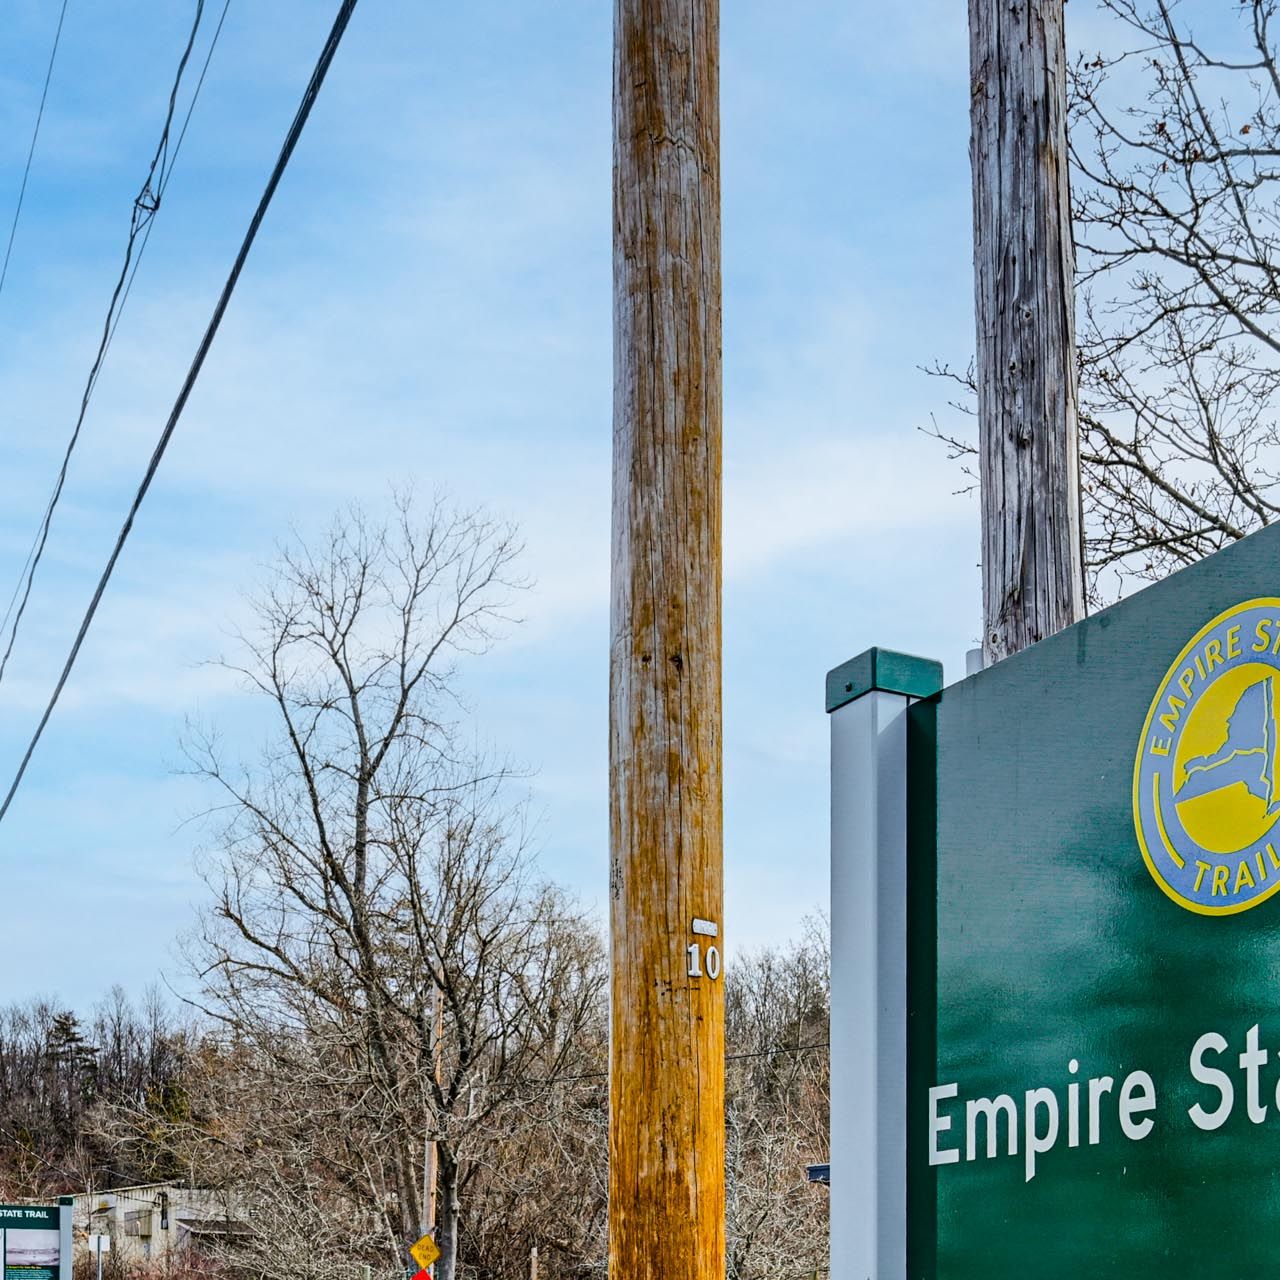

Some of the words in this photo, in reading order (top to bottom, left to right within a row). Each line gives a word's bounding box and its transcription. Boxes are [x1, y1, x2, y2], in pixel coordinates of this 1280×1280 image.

[1150, 624, 1242, 757] EMPIRE
[687, 943, 721, 980] 10
[928, 1058, 1156, 1182] Empire
[24, 1210, 49, 1218] TRAIL
[417, 1244, 434, 1252] DEAD
